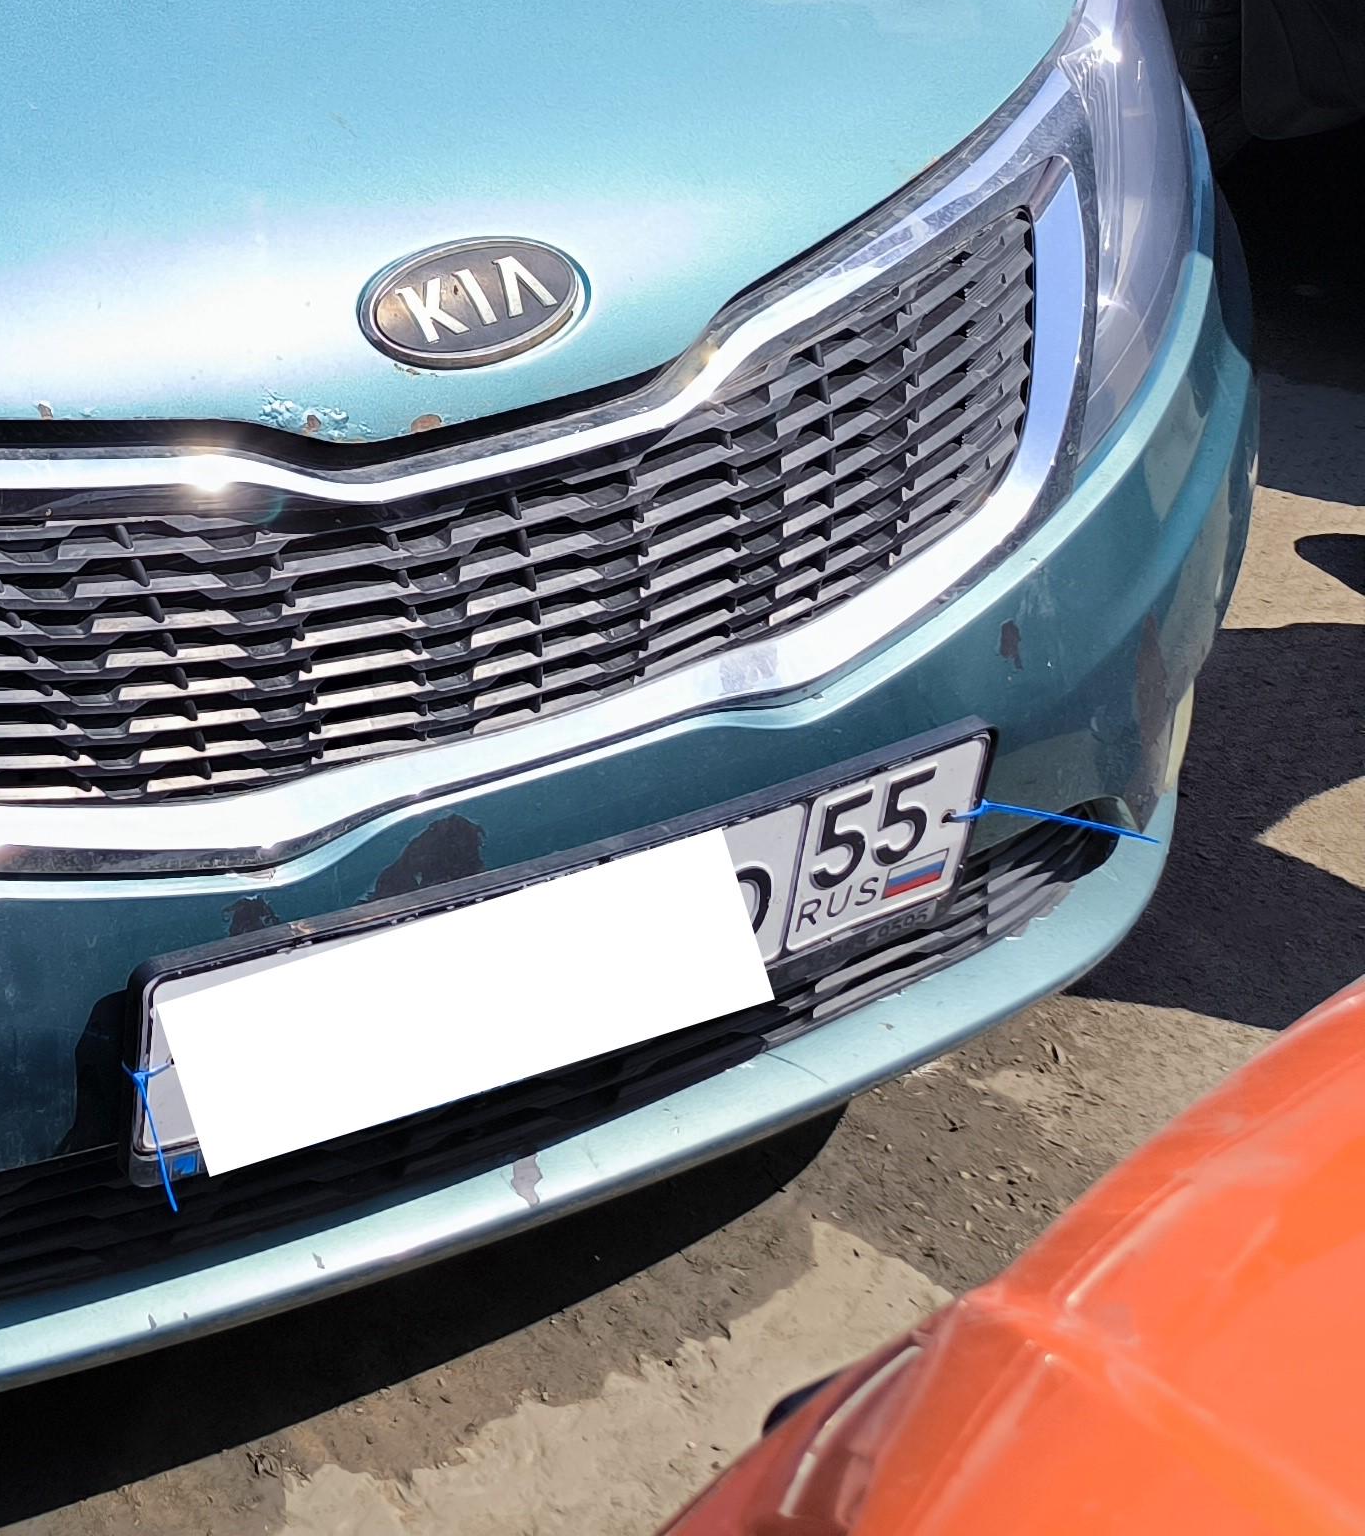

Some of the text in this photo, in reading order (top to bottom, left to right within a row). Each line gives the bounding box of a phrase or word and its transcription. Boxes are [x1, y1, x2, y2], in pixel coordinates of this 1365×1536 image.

[394, 255, 558, 344] KIA
[810, 764, 939, 891] 55
[795, 876, 880, 933] RUS
